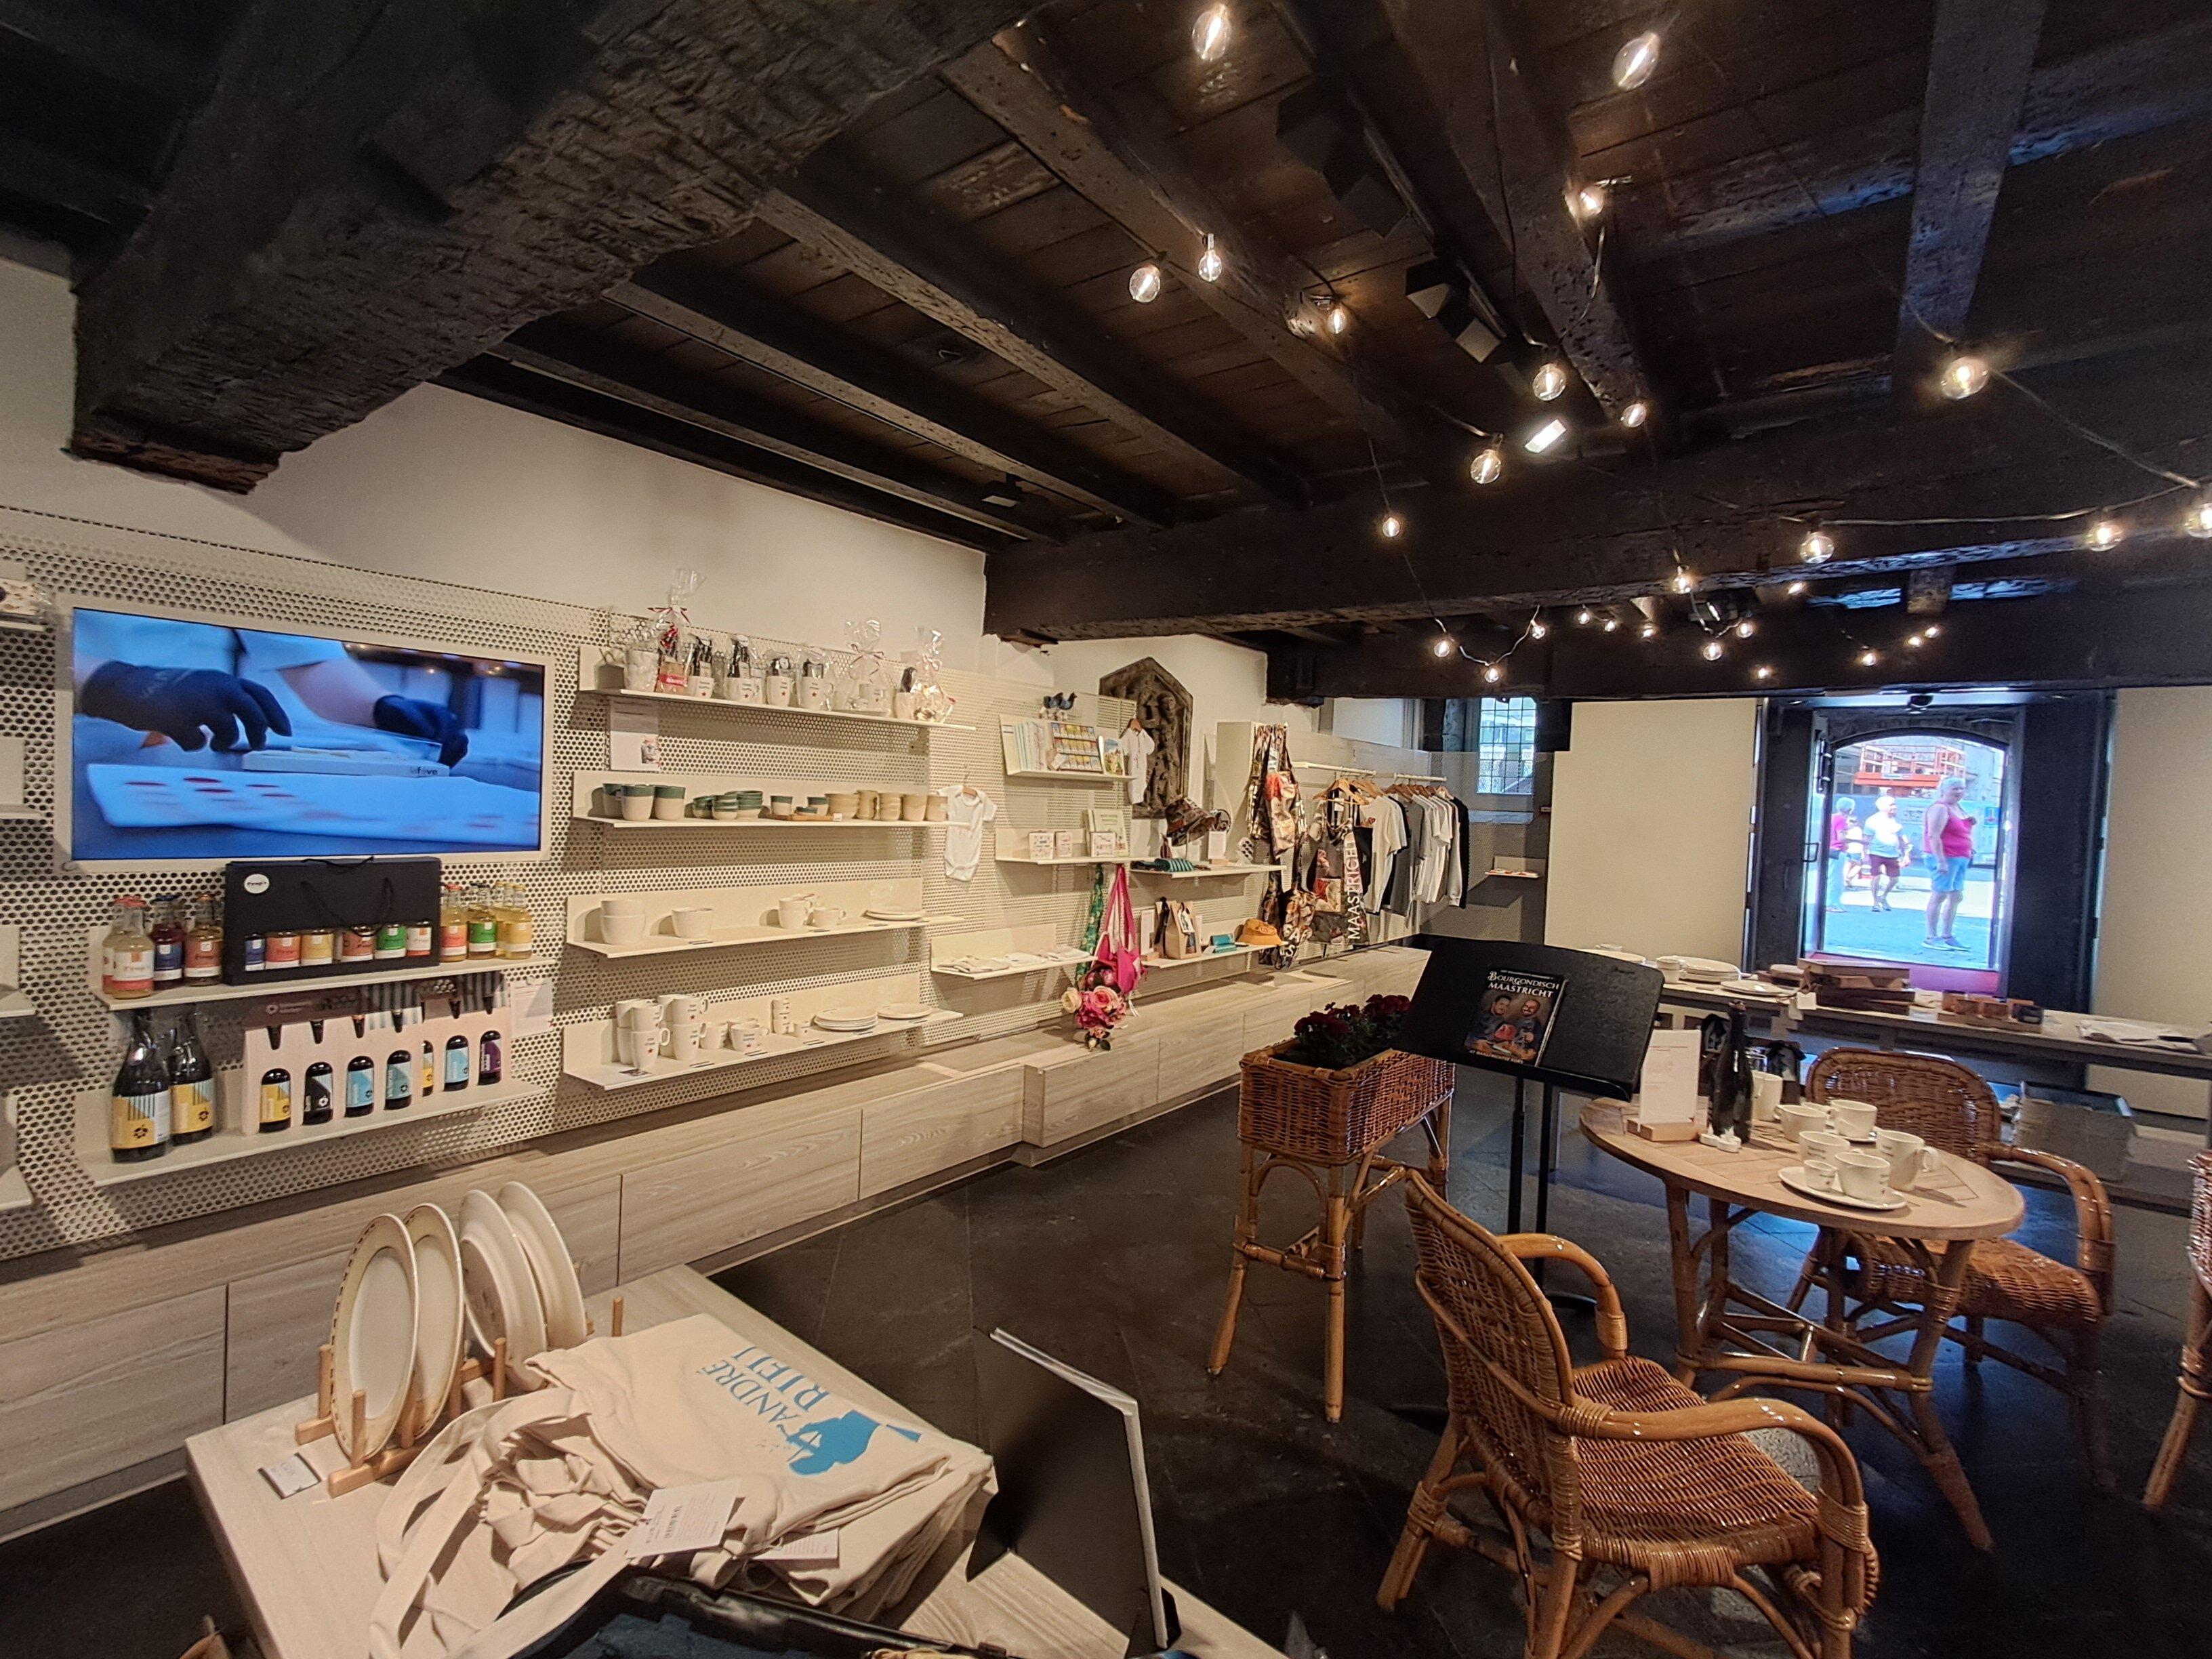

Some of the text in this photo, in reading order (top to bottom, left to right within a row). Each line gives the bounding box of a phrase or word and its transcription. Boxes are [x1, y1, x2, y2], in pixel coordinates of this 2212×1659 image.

[1345, 840, 1361, 940] MAASTRICHT
[1488, 982, 1554, 998] MAASTRICHT
[695, 1359, 801, 1424] ANDRÉ
